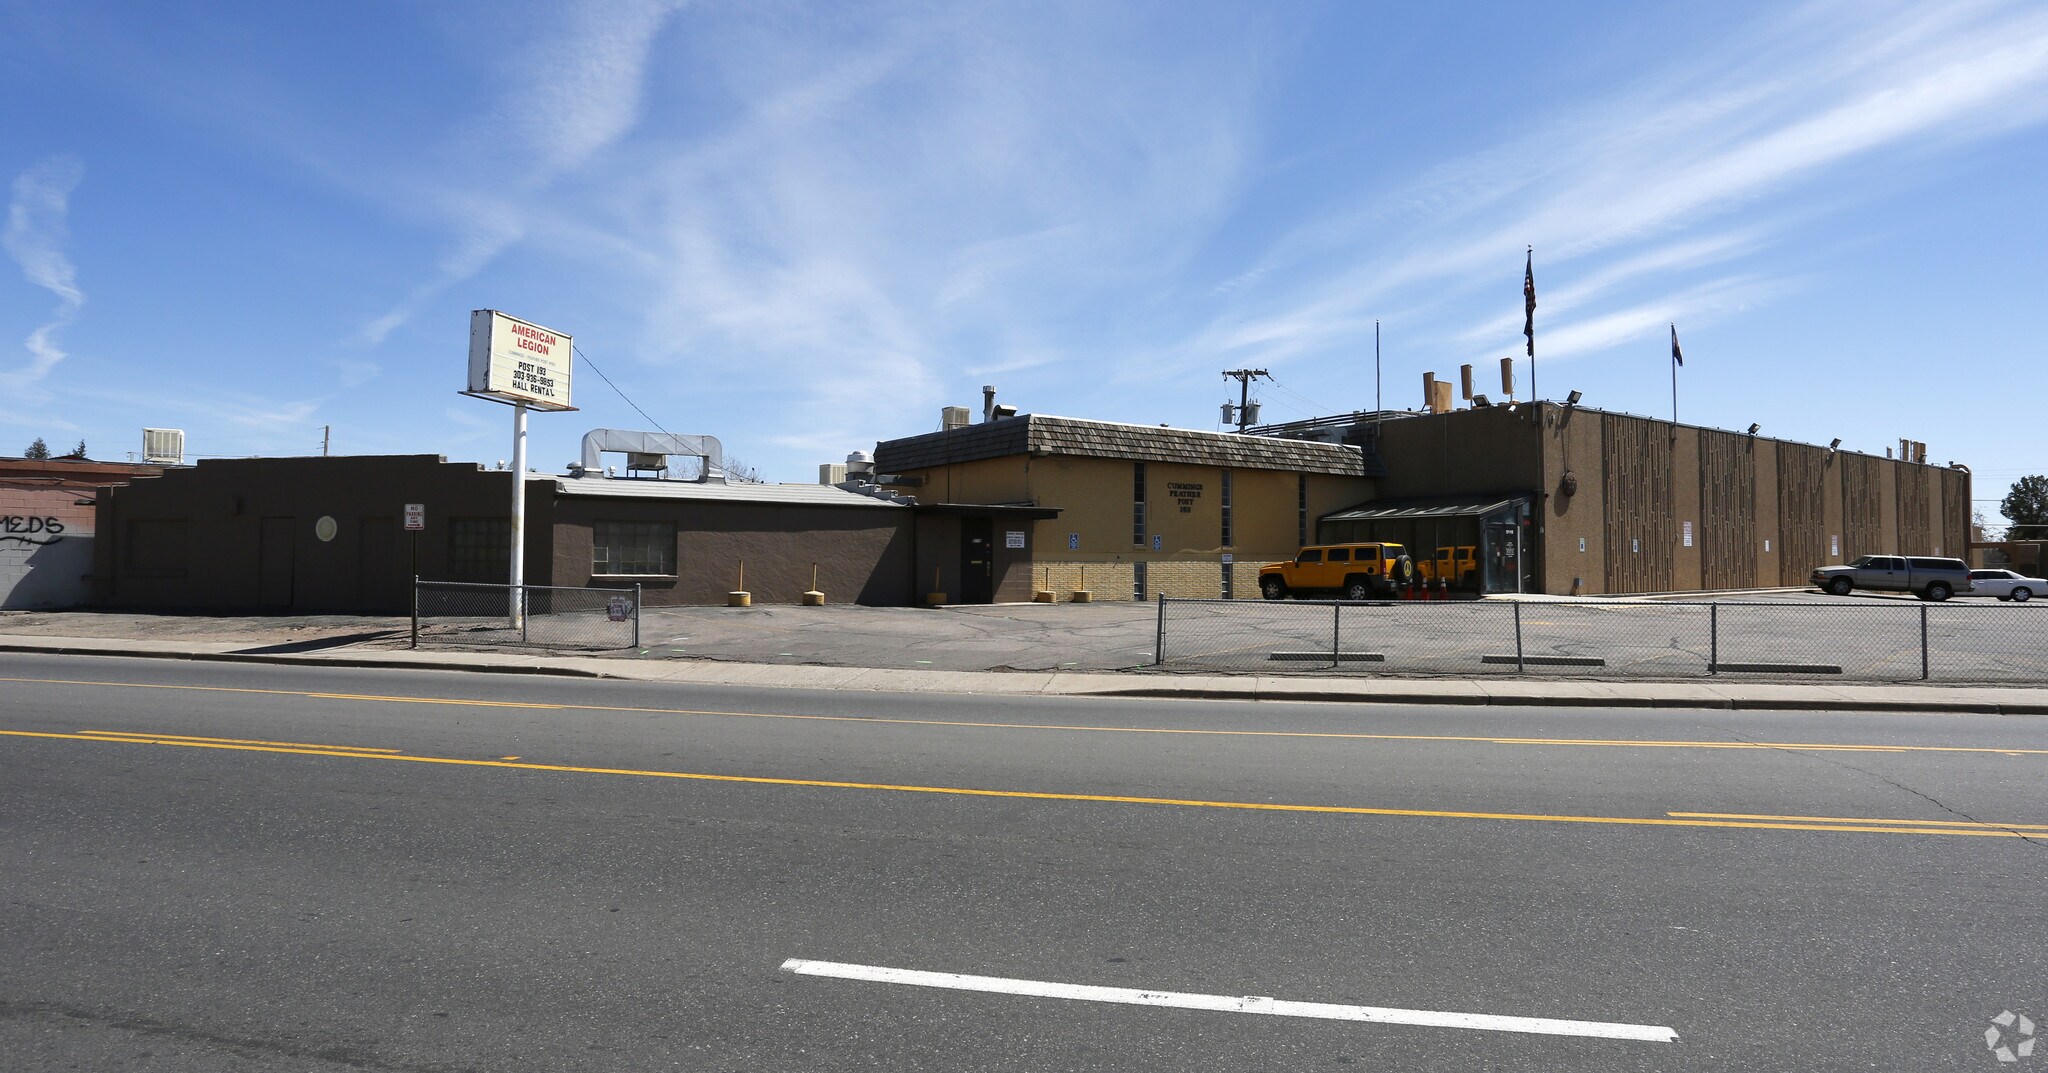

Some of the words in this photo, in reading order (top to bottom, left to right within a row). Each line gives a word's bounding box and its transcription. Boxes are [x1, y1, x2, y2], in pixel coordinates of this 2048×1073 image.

[511, 324, 556, 346] AMERICAN
[517, 338, 549, 355] LEGION
[518, 361, 534, 373] POST
[536, 366, 546, 376] 193
[512, 380, 528, 392] HALL
[530, 384, 555, 396] RENTAL
